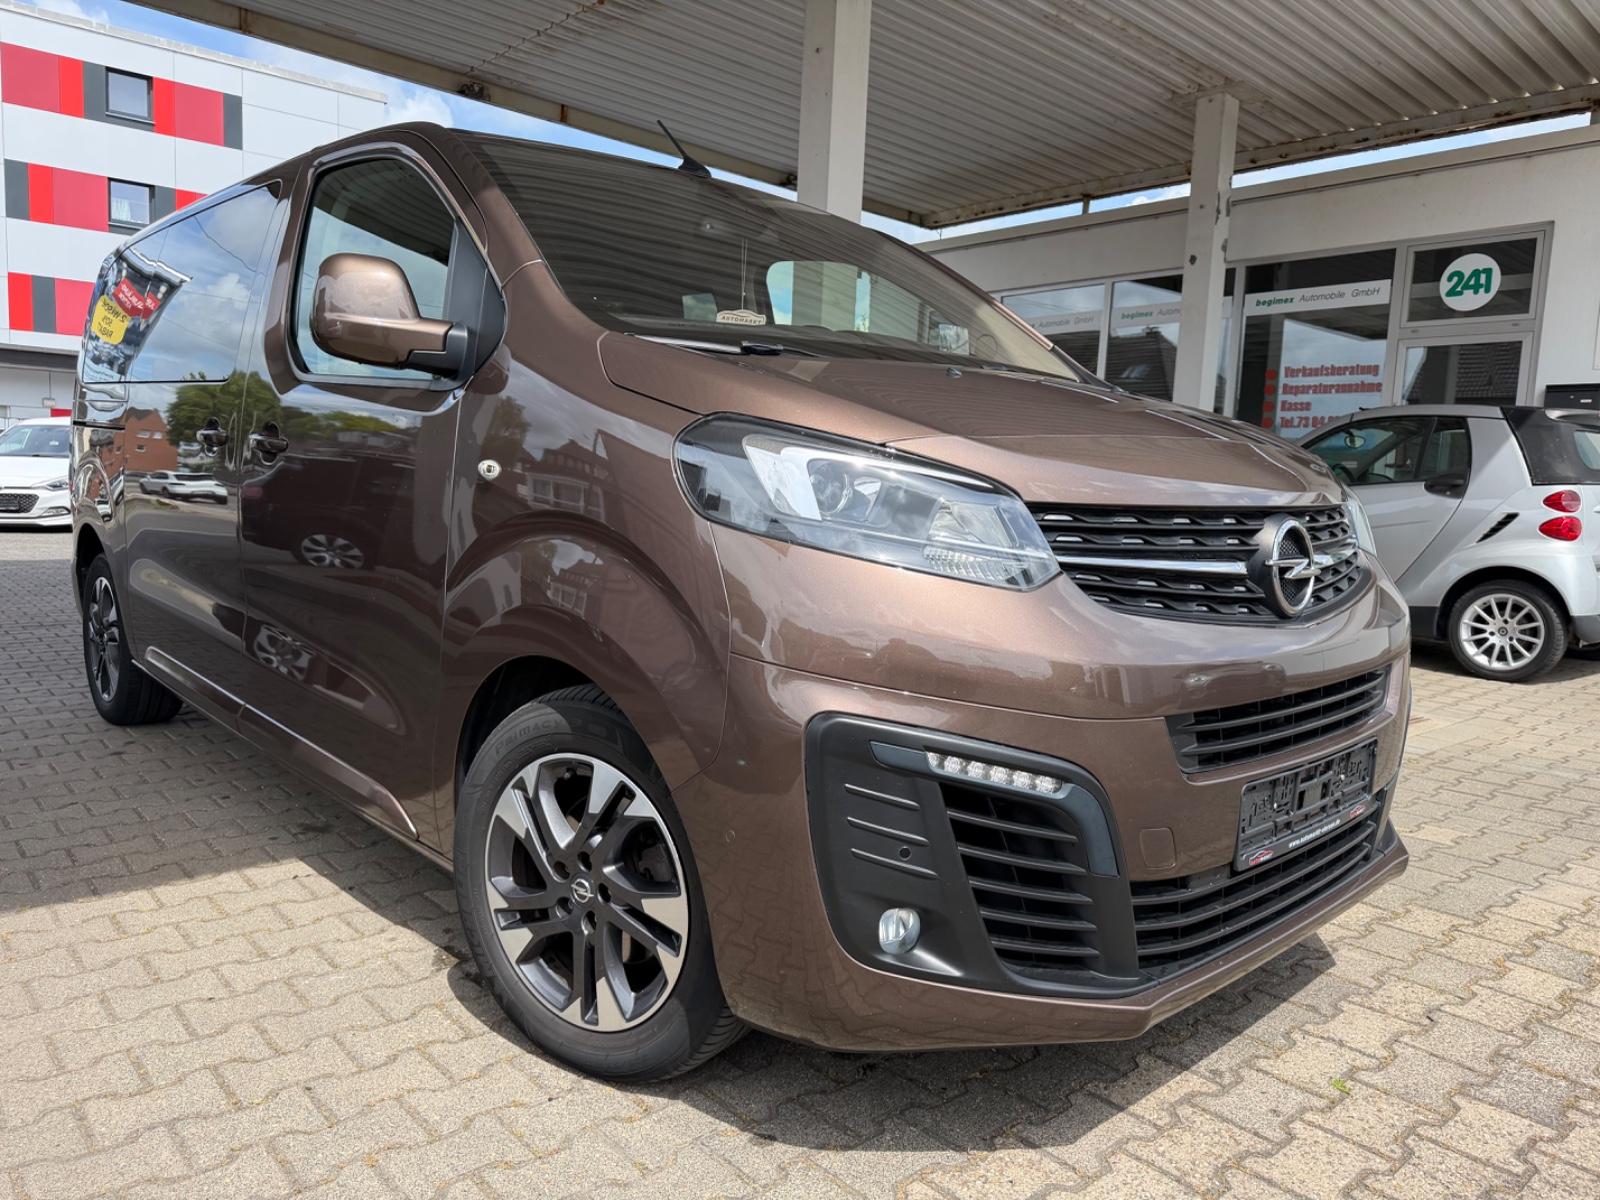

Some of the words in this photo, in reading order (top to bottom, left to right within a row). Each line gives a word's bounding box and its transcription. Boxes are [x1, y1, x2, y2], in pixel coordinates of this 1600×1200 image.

[1445, 268, 1493, 297] 241
[1255, 296, 1295, 307] begimex
[1299, 290, 1346, 303] Automobile
[1351, 287, 1381, 298] GmbH
[1284, 364, 1379, 378] Verkaufsberatung
[1282, 381, 1383, 396] Reparaturannahme
[1281, 400, 1312, 411] Kasse
